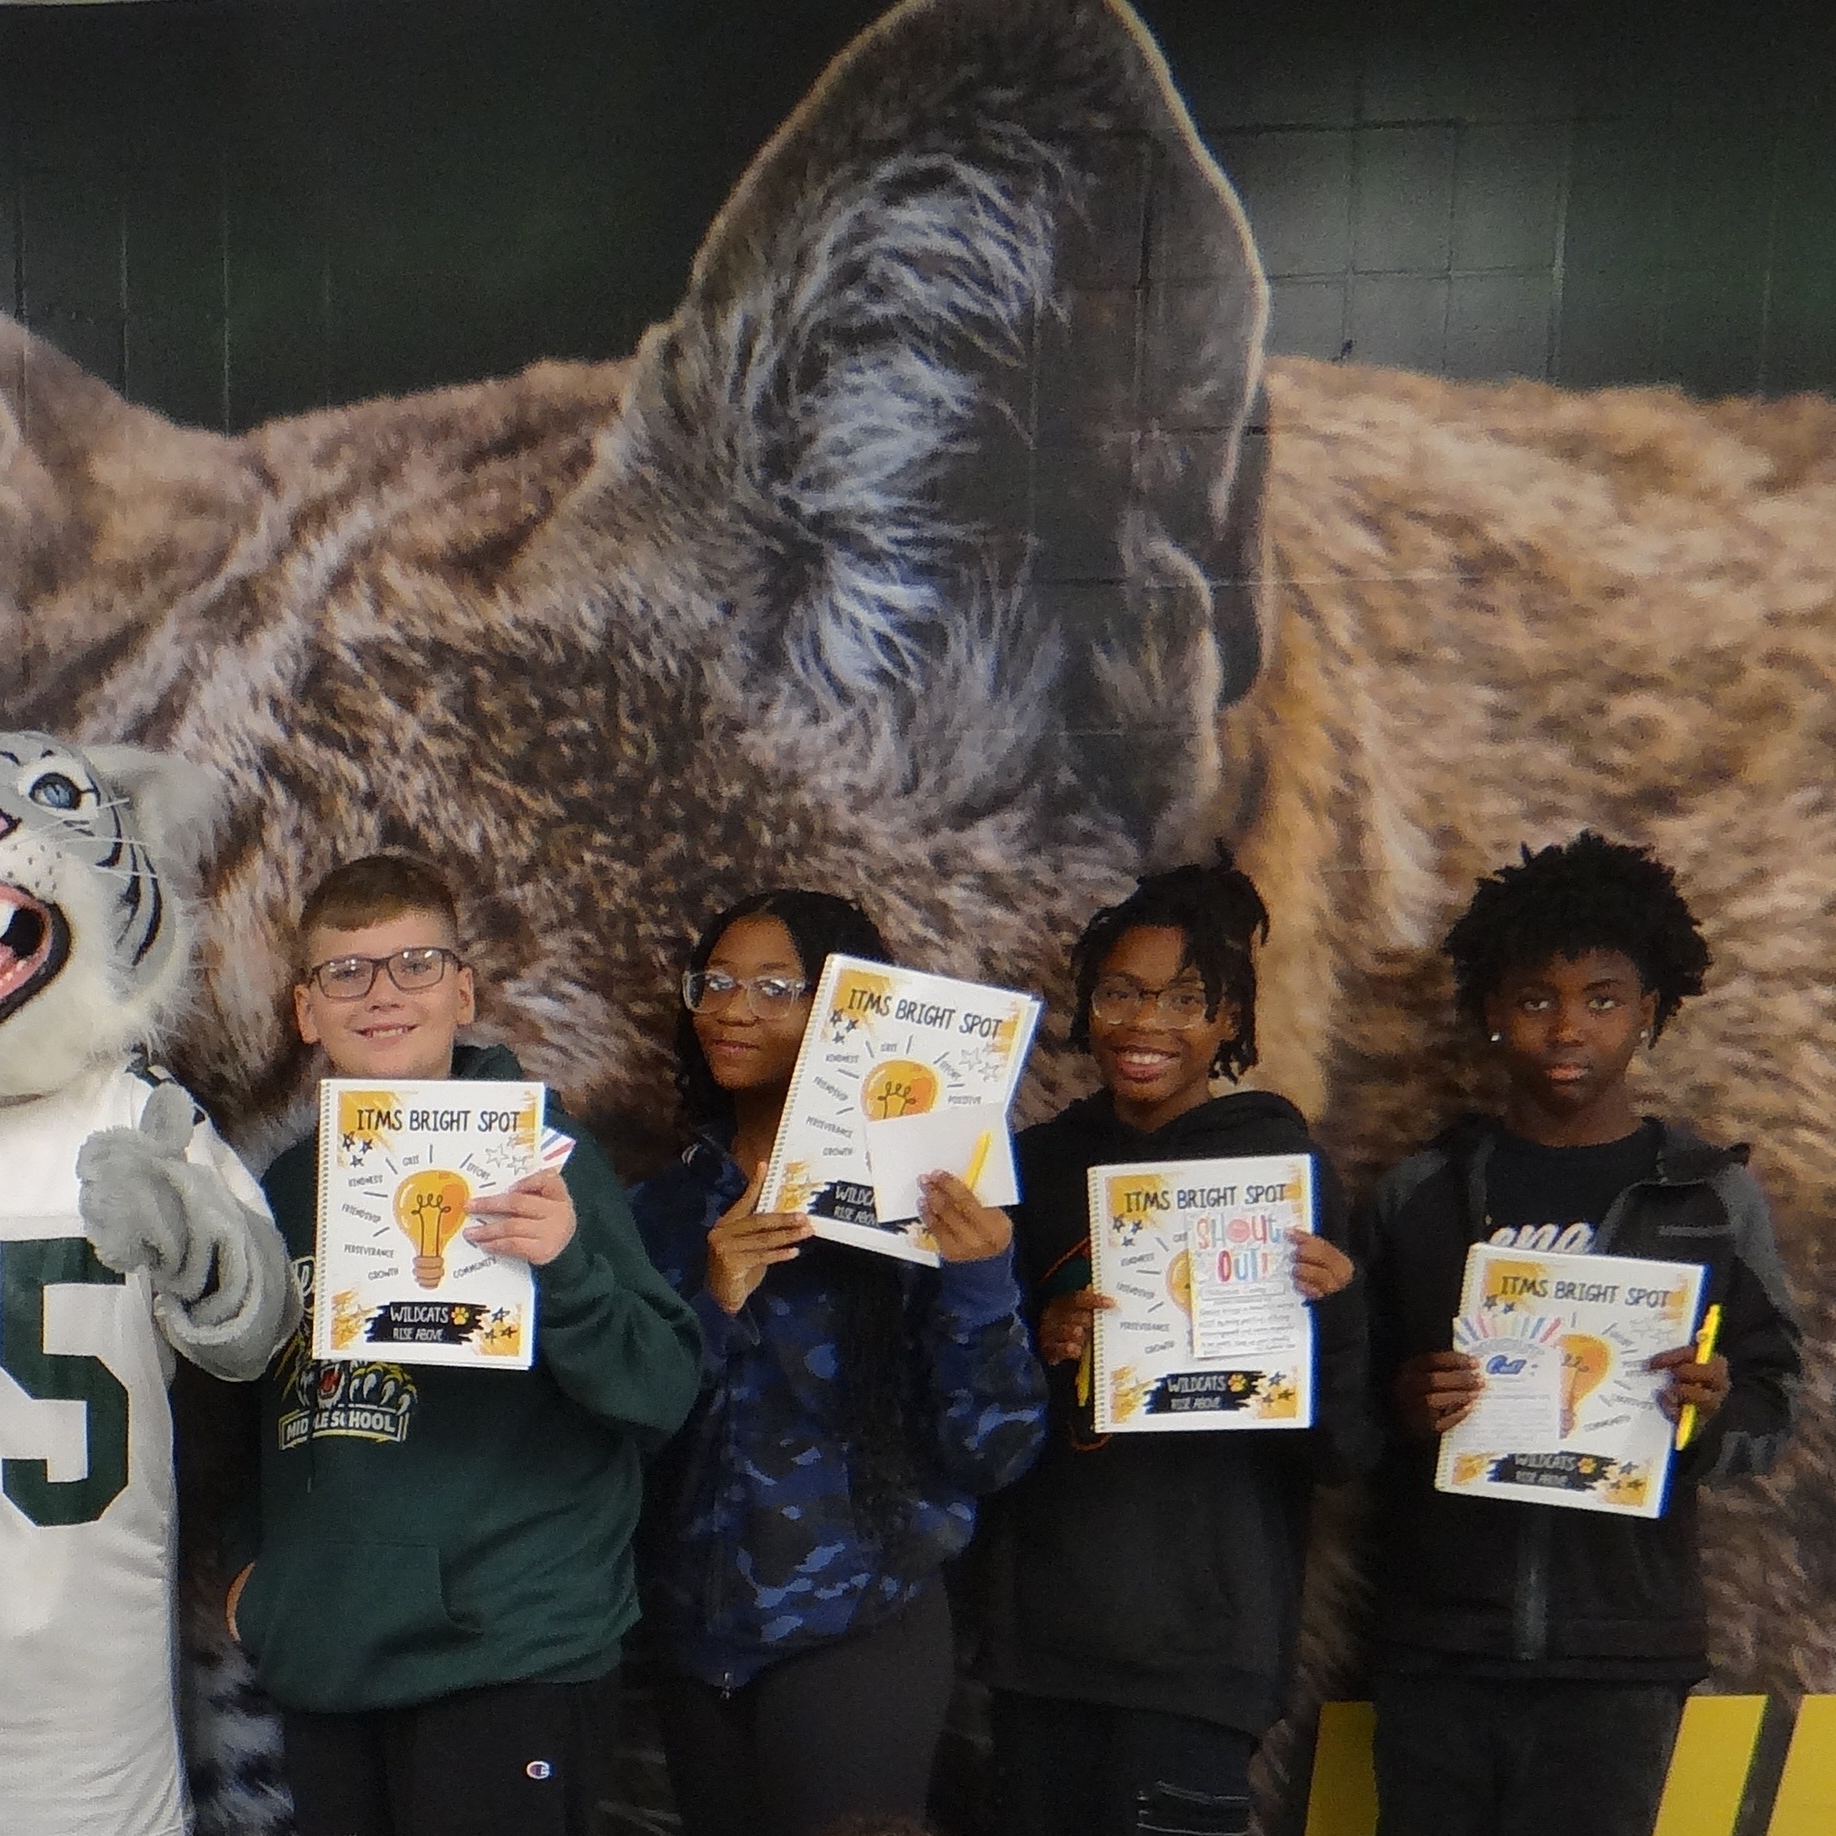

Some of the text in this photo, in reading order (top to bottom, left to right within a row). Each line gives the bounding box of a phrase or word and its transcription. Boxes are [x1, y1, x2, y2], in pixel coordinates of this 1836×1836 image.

[848, 988, 1002, 1040] ITMS BRIGHT SPOT
[357, 1109, 520, 1132] ITMS BRIGHT SPOT
[348, 1174, 383, 1187] KINDNESS
[835, 1186, 875, 1204] WILDC
[1124, 1183, 1286, 1213] ITMS BRIGHT SPOT
[341, 1203, 381, 1224] FRIENDSHIP
[344, 1244, 394, 1259] PERSEVERANCE
[368, 1267, 399, 1281] GROWTH
[1501, 1276, 1670, 1309] ITMS BRIGHT SPOT
[390, 1306, 449, 1324] WILDCATS
[393, 1328, 443, 1341] RISE ABOVE
[1167, 1375, 1227, 1393] WILDCATS
[286, 1411, 329, 1441] MIDLE
